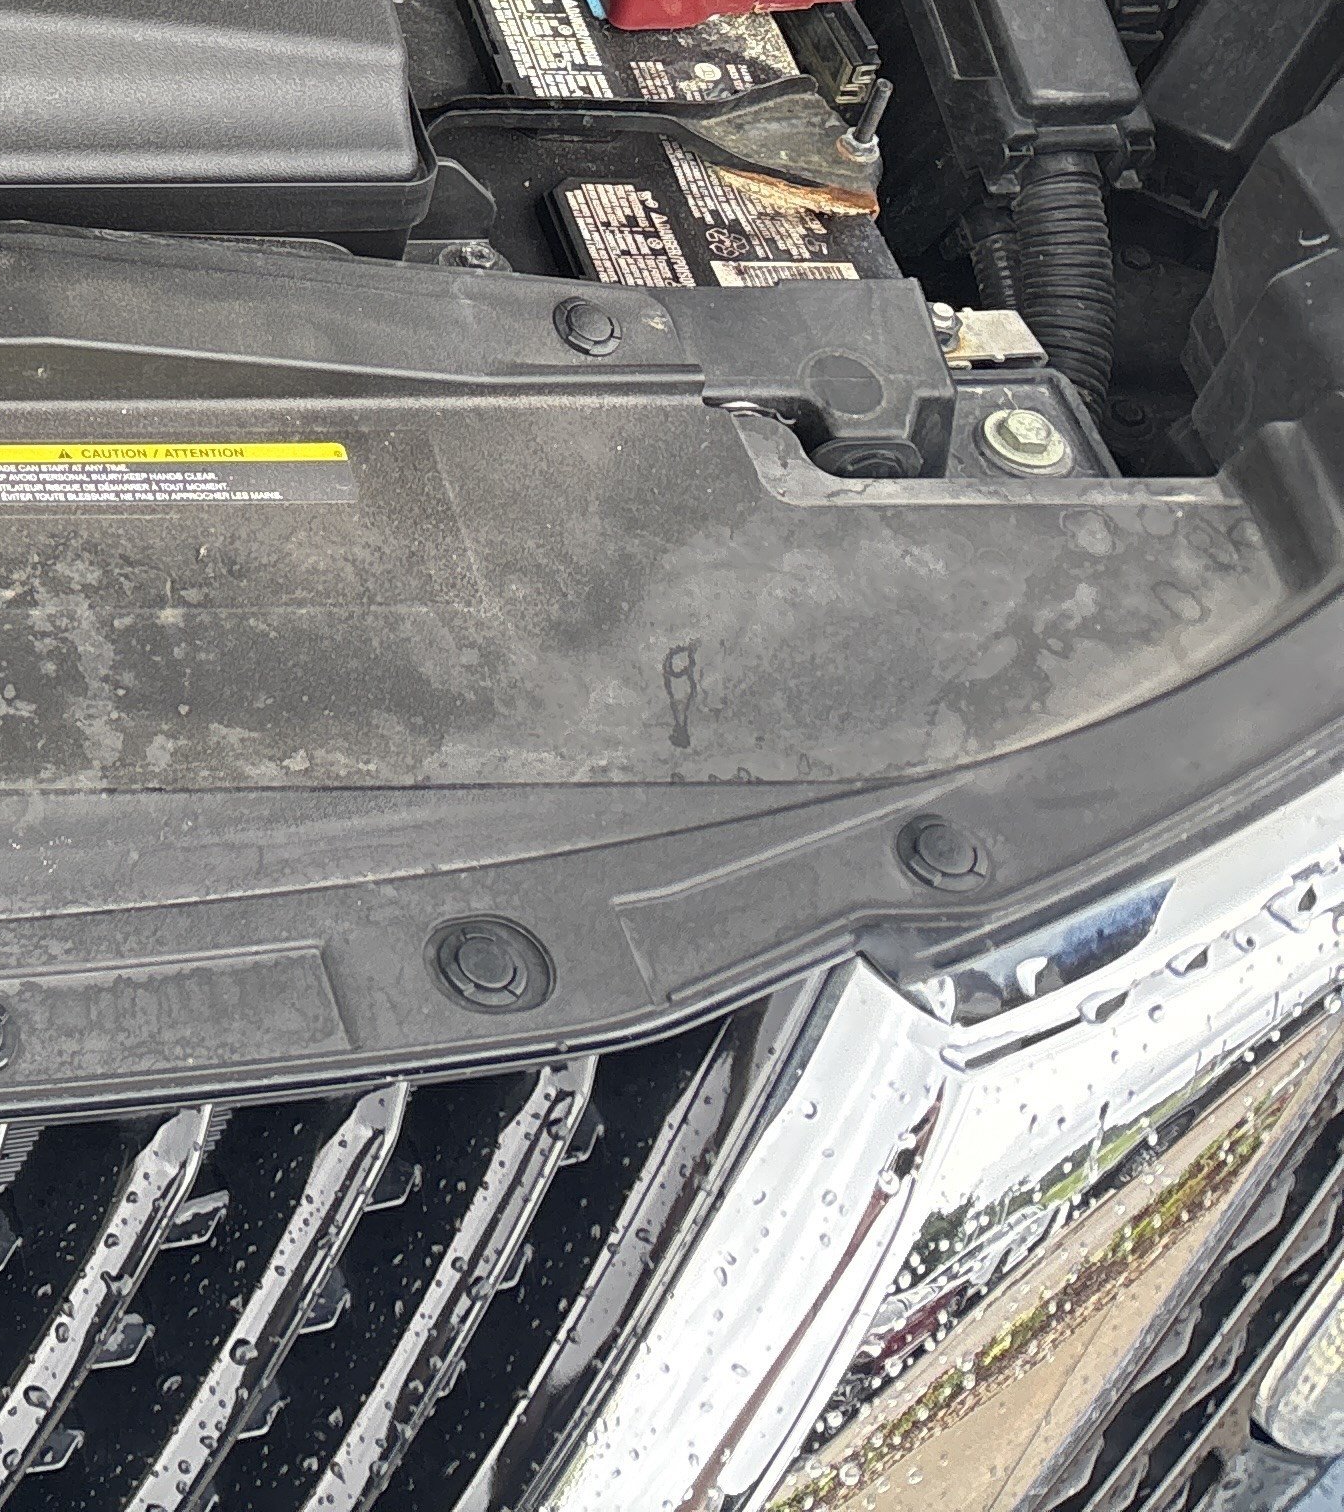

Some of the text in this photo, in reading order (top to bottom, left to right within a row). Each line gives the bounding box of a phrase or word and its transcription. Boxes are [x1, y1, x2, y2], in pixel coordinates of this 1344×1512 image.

[81, 448, 148, 459] CAUTION
[165, 448, 245, 459] ATTENTION
[18, 464, 40, 473] CAN
[84, 464, 104, 472] ANY
[9, 473, 38, 482] AVOID
[161, 482, 186, 491] TOUT
